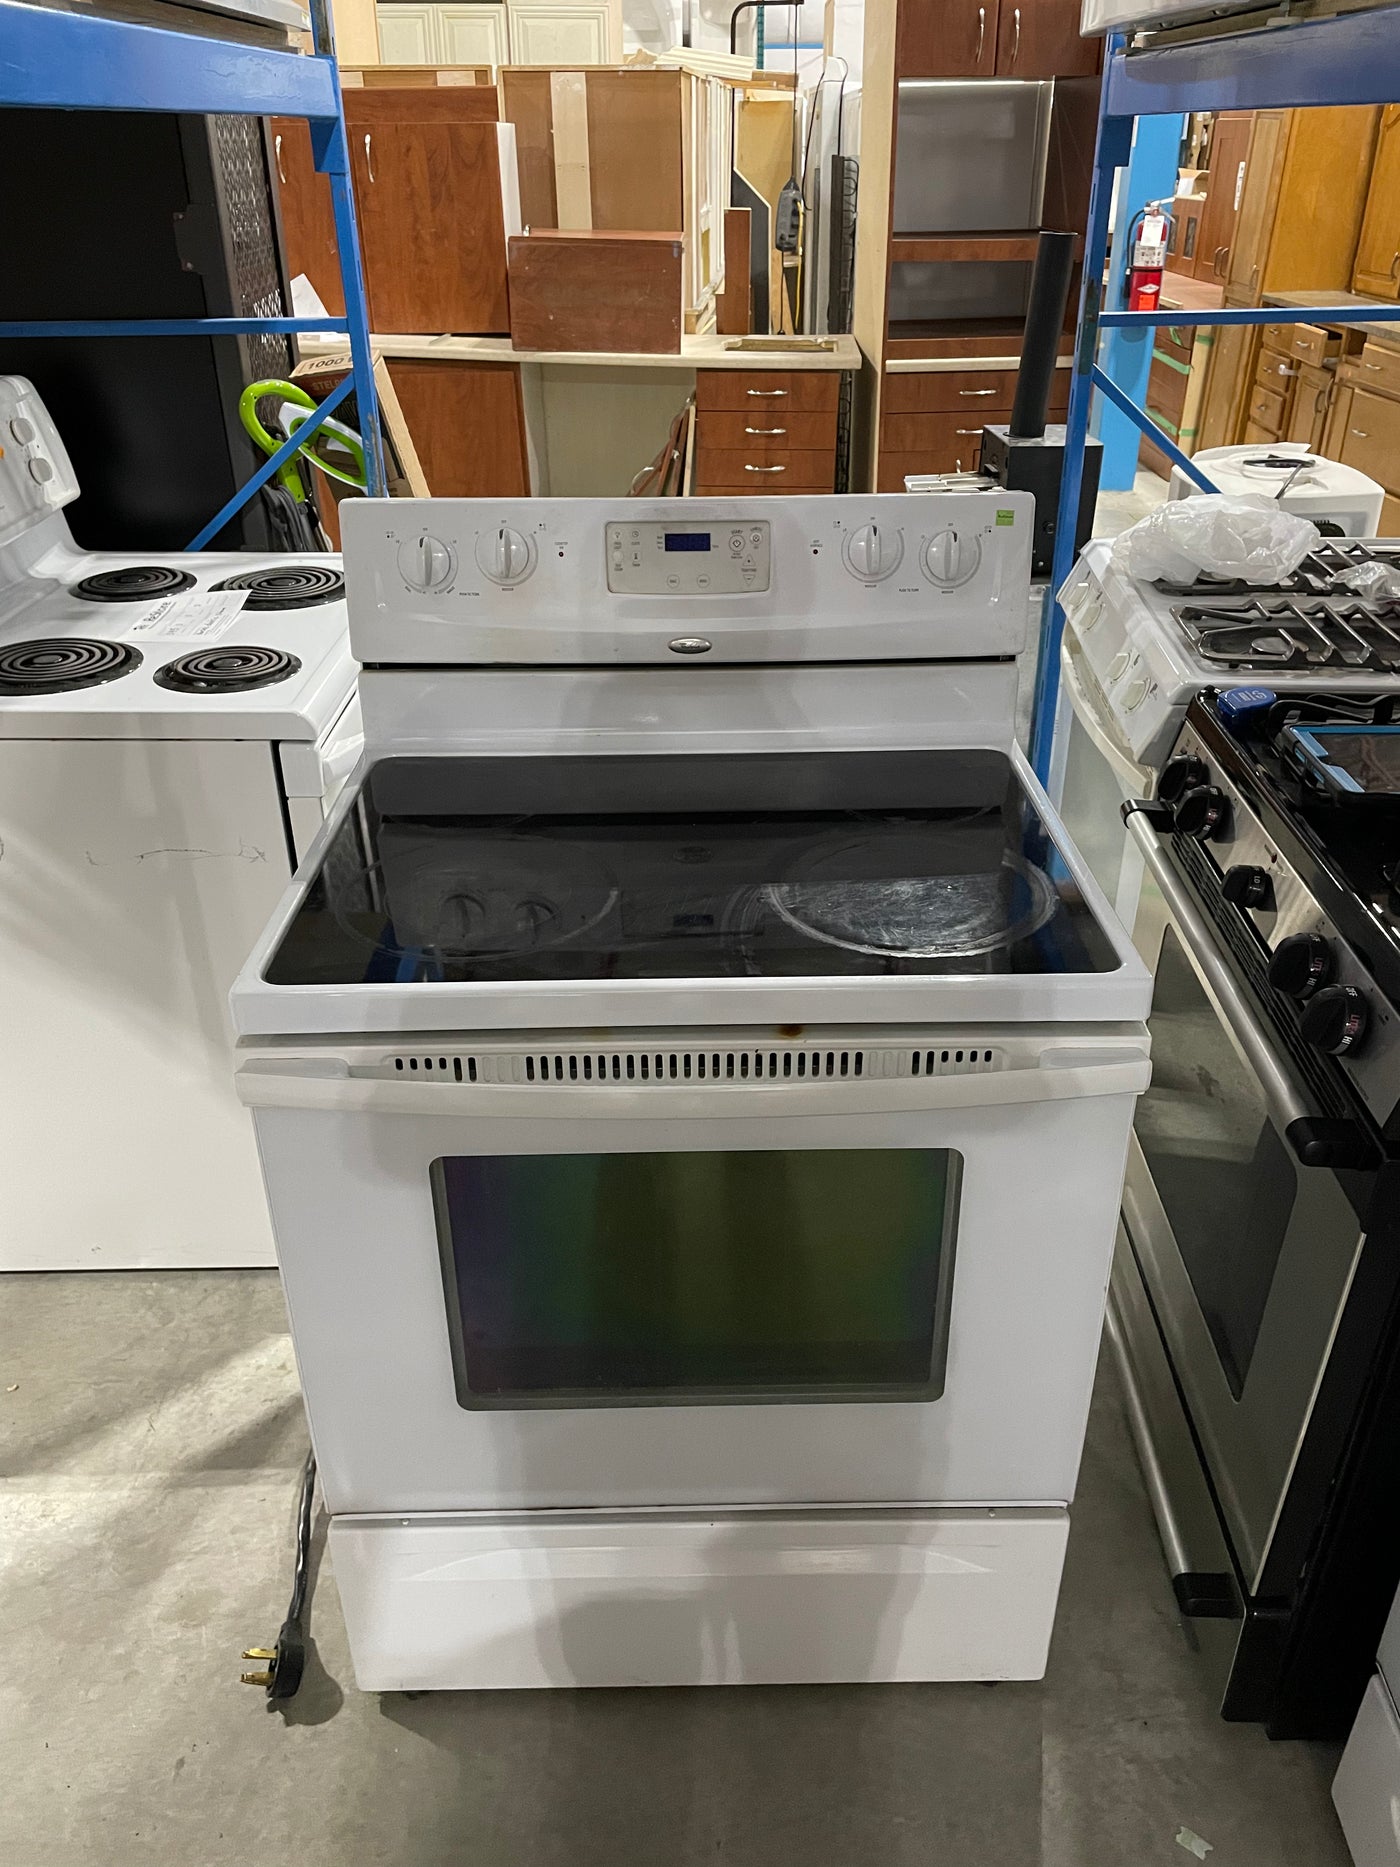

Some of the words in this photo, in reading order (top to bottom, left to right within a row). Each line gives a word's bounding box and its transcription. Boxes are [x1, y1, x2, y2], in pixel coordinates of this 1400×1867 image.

[308, 357, 345, 370] 1000
[1306, 977, 1318, 986] HI
[1342, 1036, 1353, 1045] HI
